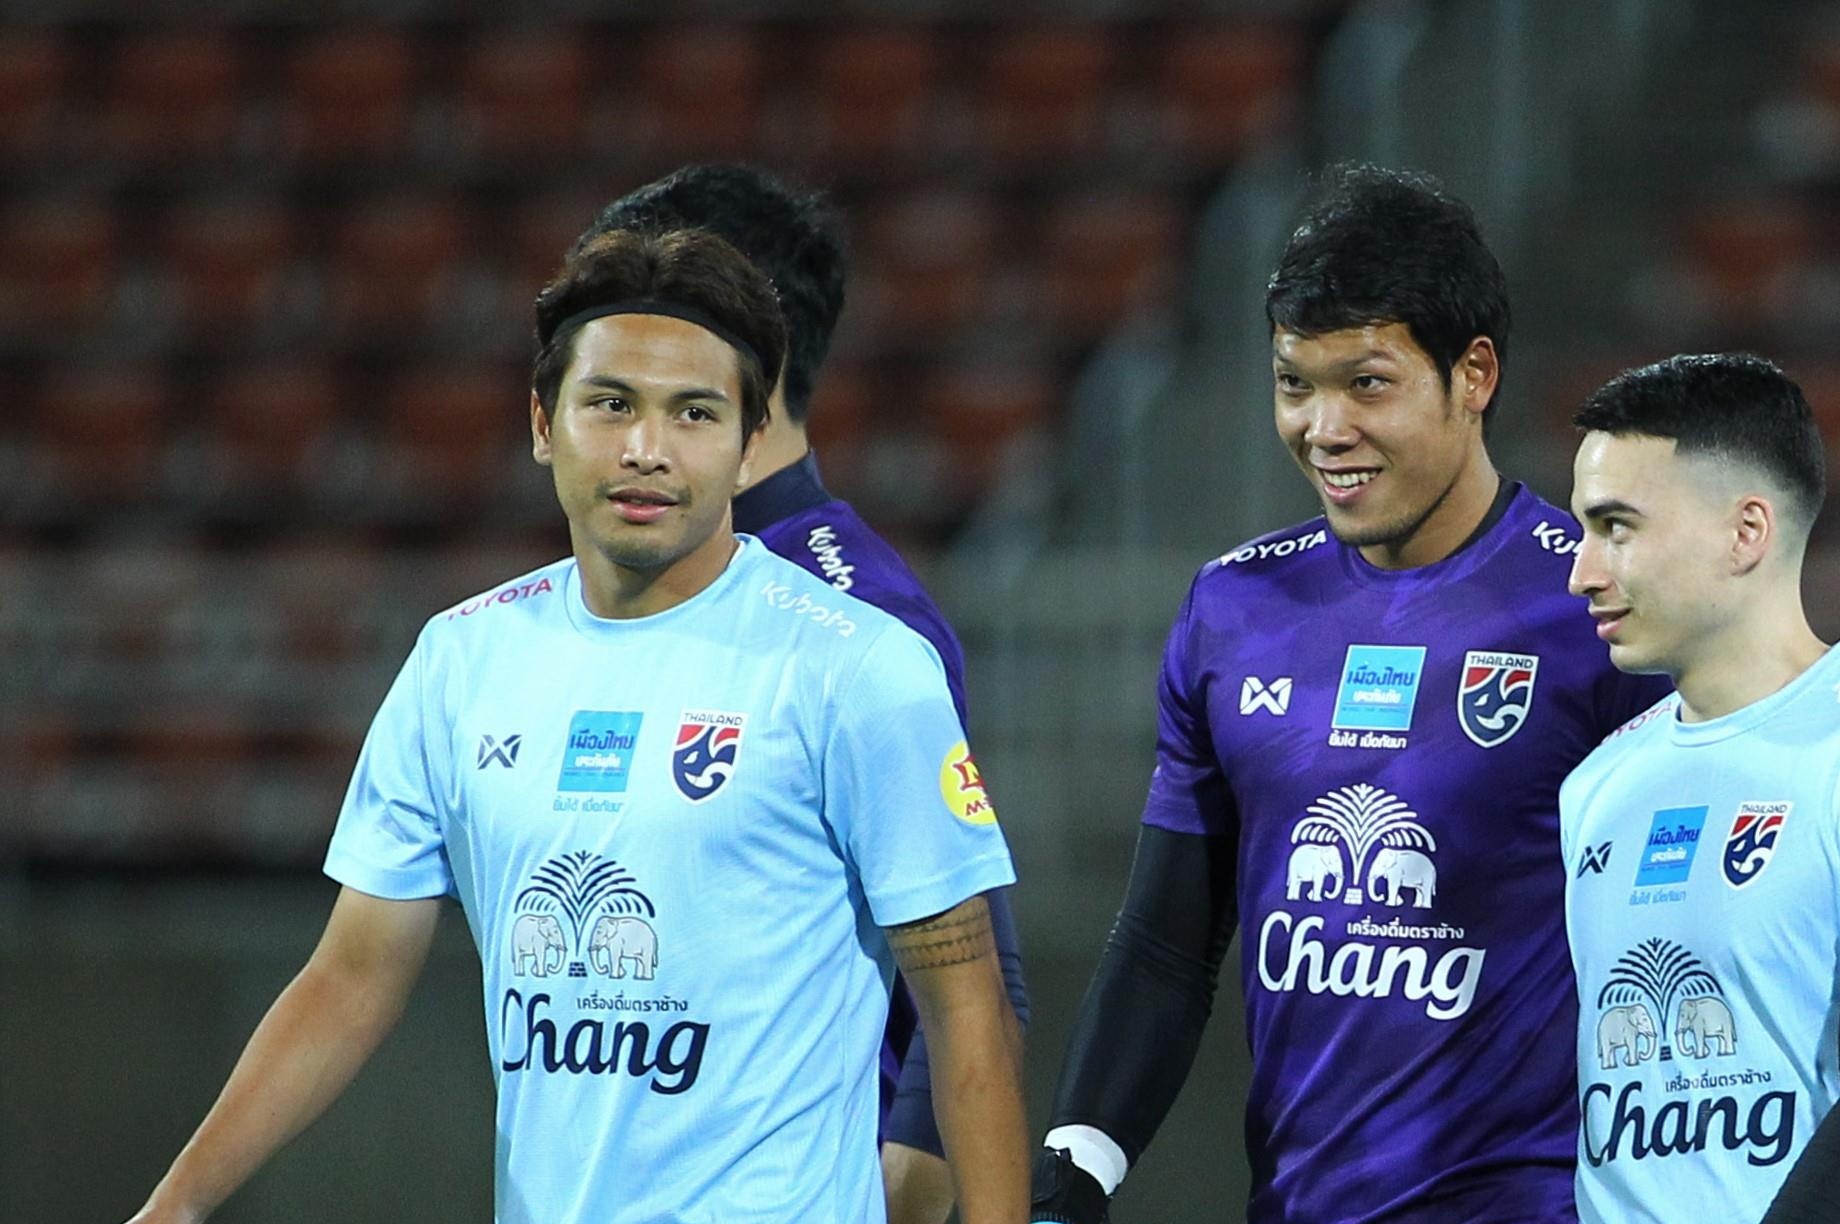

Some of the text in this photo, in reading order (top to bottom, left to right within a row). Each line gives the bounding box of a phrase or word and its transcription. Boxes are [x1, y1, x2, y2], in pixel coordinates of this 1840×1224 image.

[808, 526, 854, 591] Kubota
[1219, 530, 1327, 566] TOYOTA
[759, 580, 857, 637] Kubota
[1346, 665, 1416, 687] เมืองไทย
[1470, 655, 1535, 669] THAILAND
[684, 711, 744, 726] THAILAND
[568, 728, 635, 750] เมืองไทย
[1346, 915, 1464, 940] เครื่องดื่มตราช้าง
[1258, 910, 1486, 1020] Chang
[502, 987, 711, 1095] Chang
[1582, 1080, 1797, 1168] Chang
